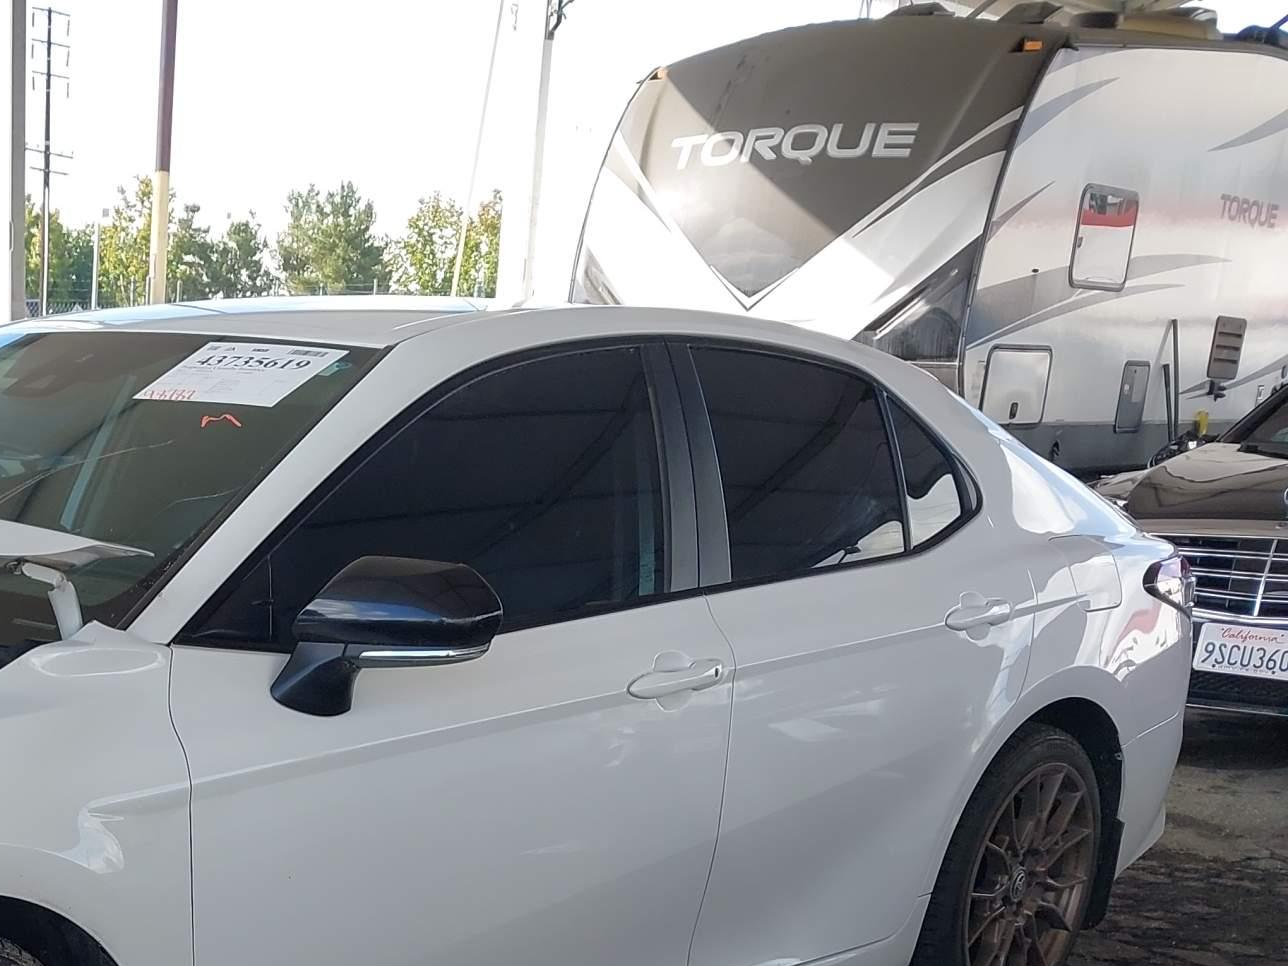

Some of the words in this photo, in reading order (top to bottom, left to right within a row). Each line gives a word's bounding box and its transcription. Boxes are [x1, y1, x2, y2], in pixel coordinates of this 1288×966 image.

[671, 122, 920, 170] TORQUE
[1220, 193, 1280, 229] TORQUE
[197, 355, 311, 370] 43735619
[1221, 628, 1278, 643] California
[1200, 642, 1288, 672] 9SCU360
